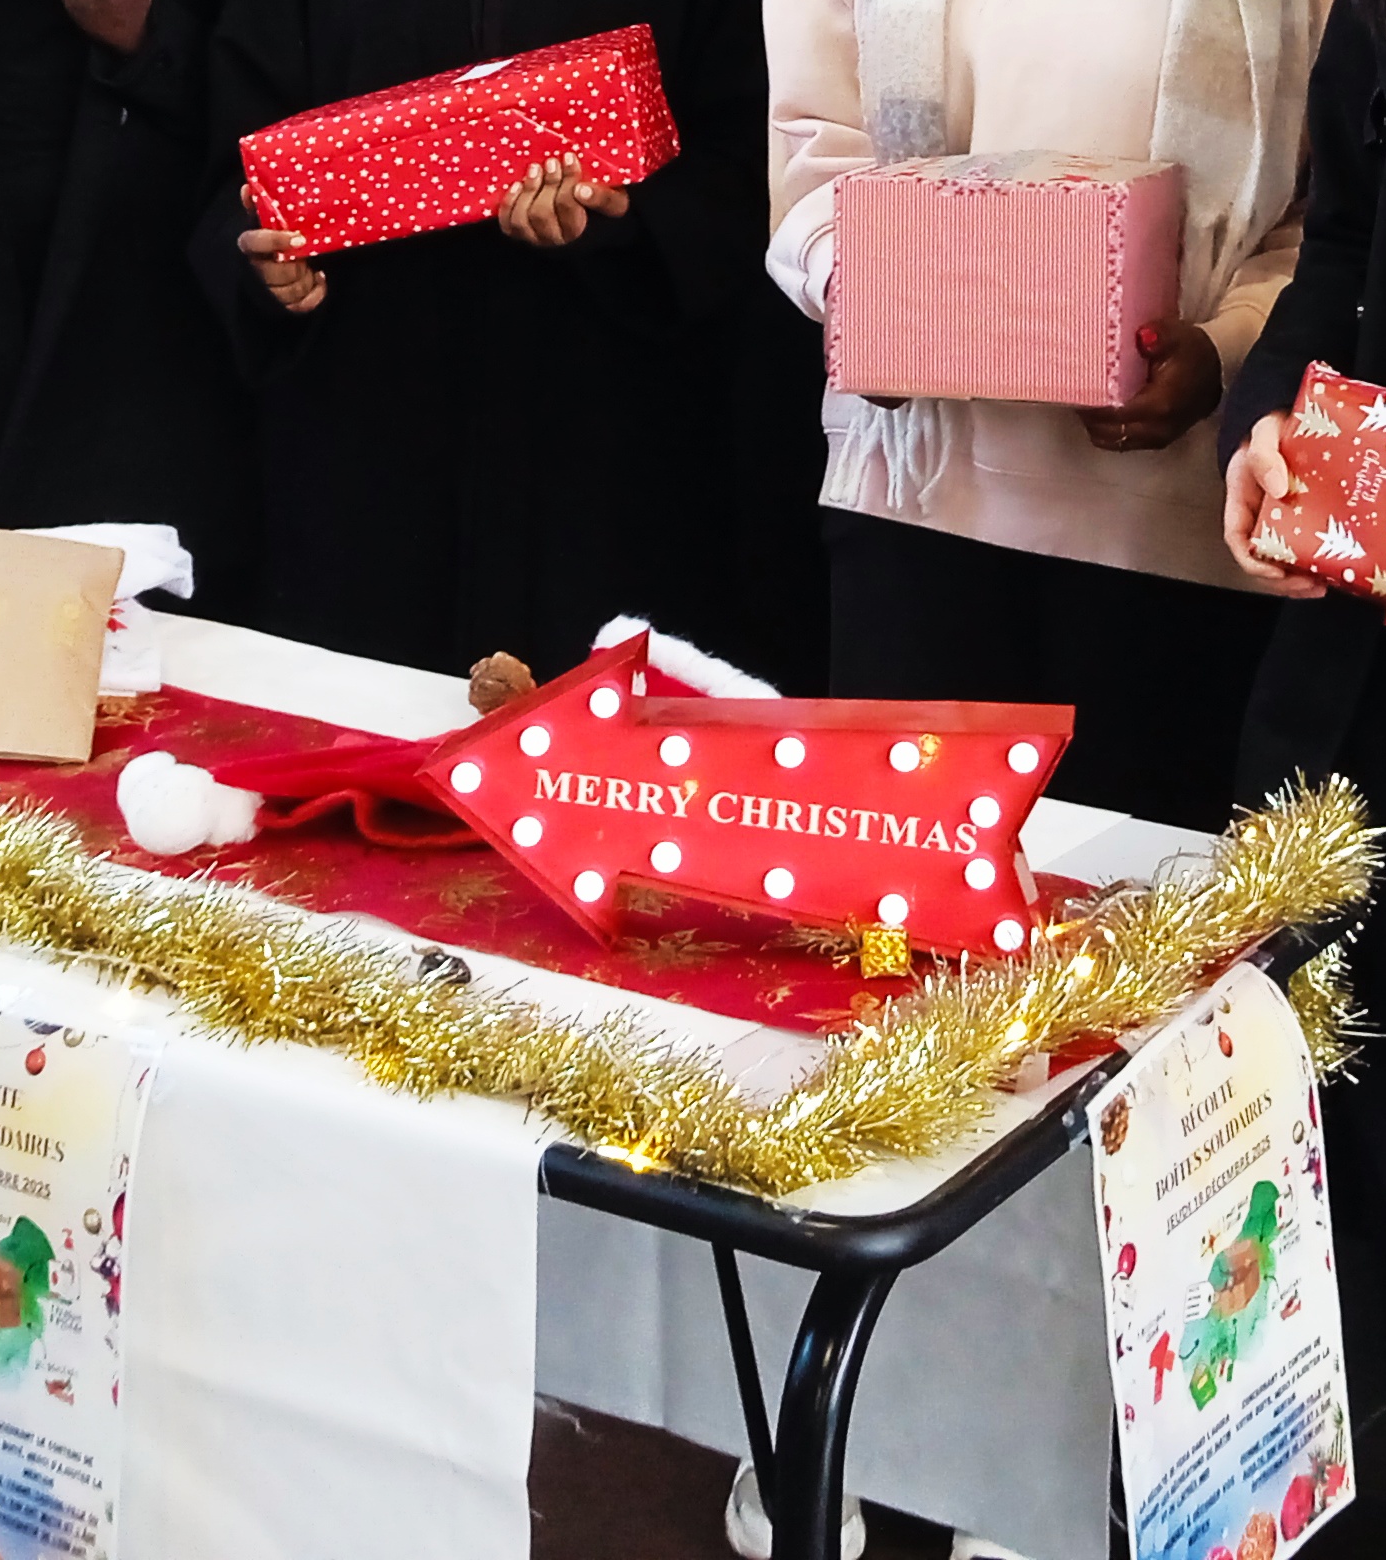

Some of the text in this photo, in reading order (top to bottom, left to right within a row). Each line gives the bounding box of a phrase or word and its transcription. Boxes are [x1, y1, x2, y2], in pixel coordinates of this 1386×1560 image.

[534, 768, 979, 856] MERRY CHRISTMAS
[1155, 1088, 1273, 1201] BOÎTES SOLIDAIRES
[1180, 1077, 1237, 1137] RÉCOLTE
[22, 1176, 52, 1200] 2025
[1166, 1203, 1193, 1236] JEUDI
[1205, 1150, 1250, 1202] DÉCEMBRE
